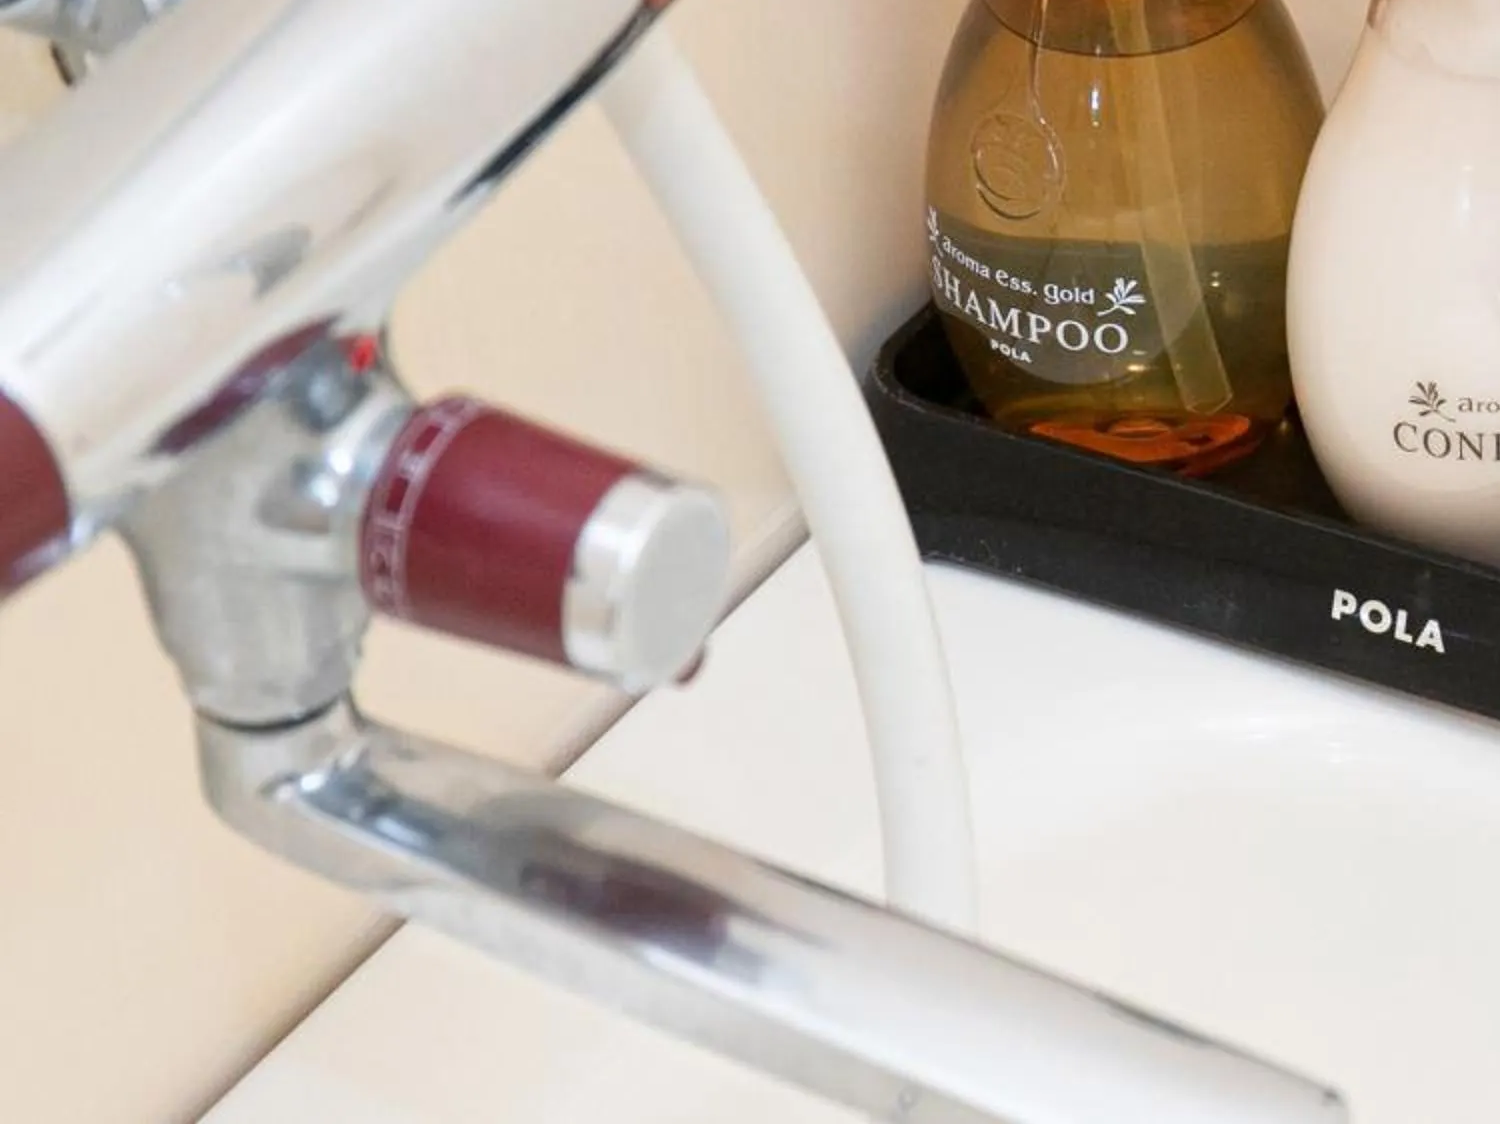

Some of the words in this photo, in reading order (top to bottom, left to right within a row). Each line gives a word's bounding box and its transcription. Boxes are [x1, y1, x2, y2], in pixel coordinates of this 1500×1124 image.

[931, 254, 1129, 354] SHAMPOO
[942, 235, 991, 280] aroma
[995, 268, 1038, 296] ess.
[1043, 282, 1096, 306] gold
[990, 338, 1033, 364] POLA
[1331, 587, 1446, 654] POLA
